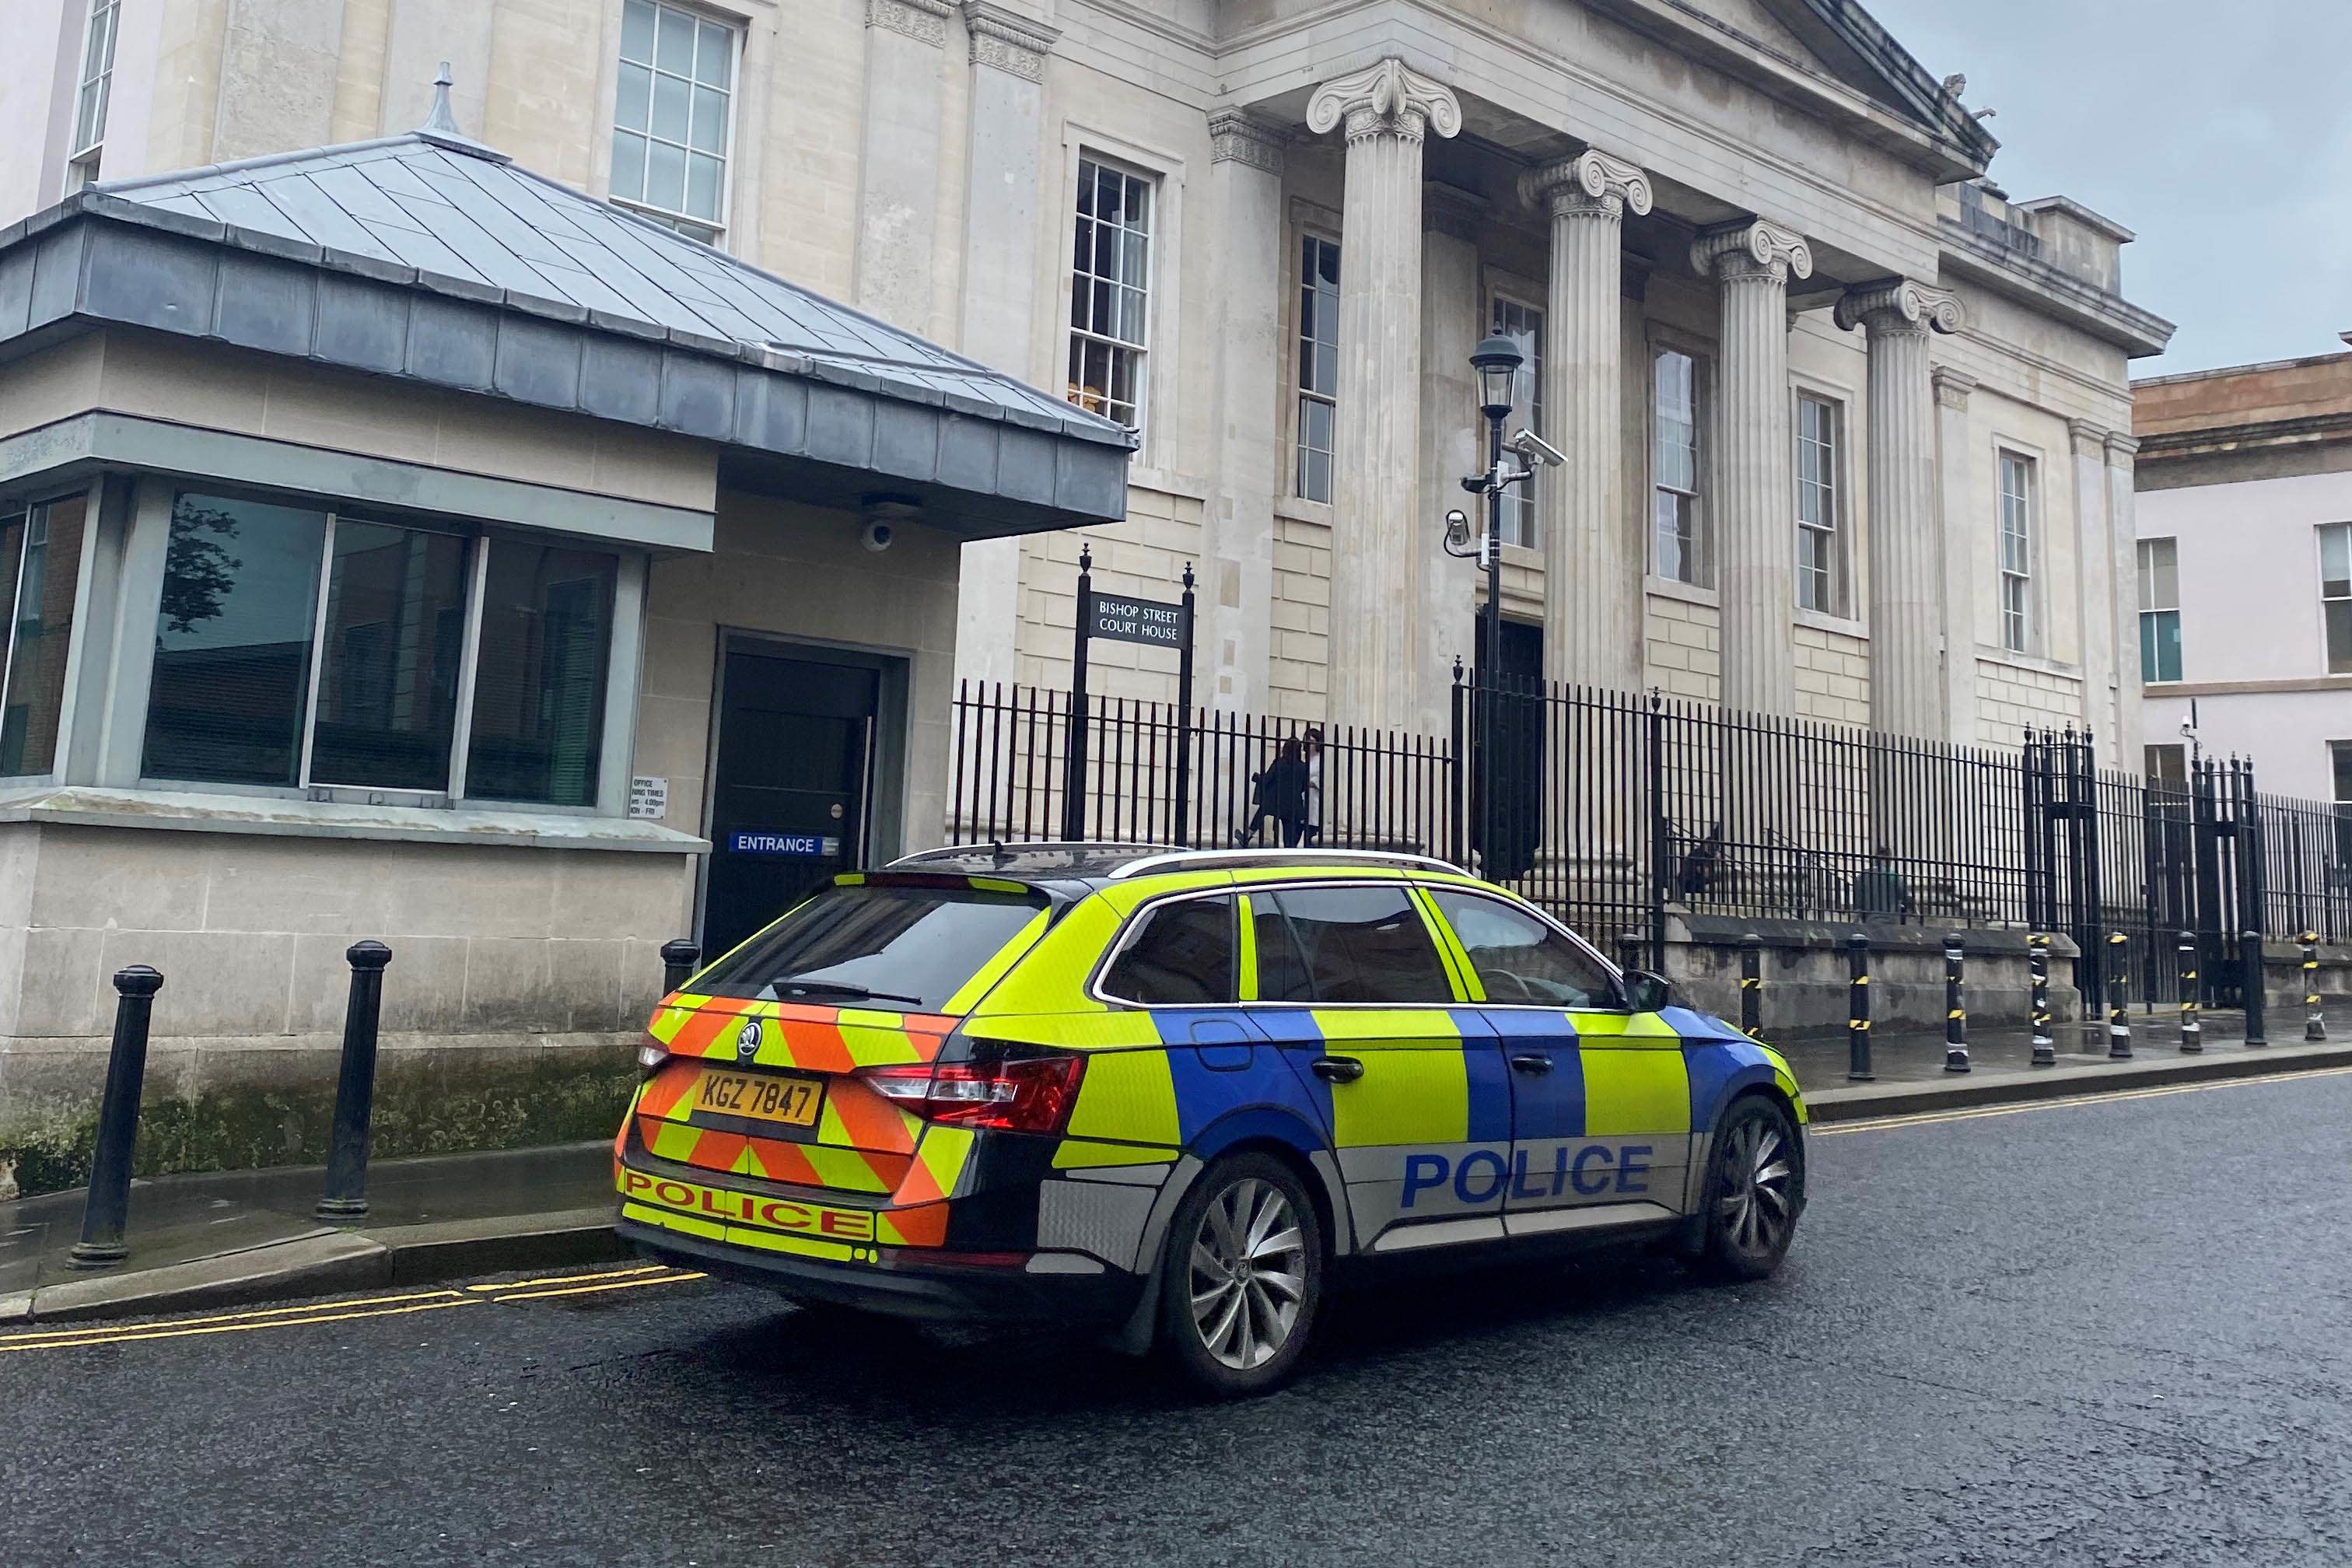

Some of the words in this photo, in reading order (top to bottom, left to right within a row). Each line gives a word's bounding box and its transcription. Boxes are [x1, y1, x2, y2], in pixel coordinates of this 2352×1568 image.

[1099, 601, 1139, 618] BISHOP
[1143, 608, 1178, 624] STREET
[1099, 618, 1137, 634] COURT
[1141, 624, 1178, 640] HOUSE
[634, 779, 653, 788] OFFICE
[647, 789, 664, 797] TIMES
[738, 835, 814, 852] ENTRANCE
[702, 1075, 748, 1109] KGZ
[751, 1080, 811, 1118] 7847
[1400, 1145, 1654, 1208] POLICE
[625, 1172, 871, 1239] POLICE
